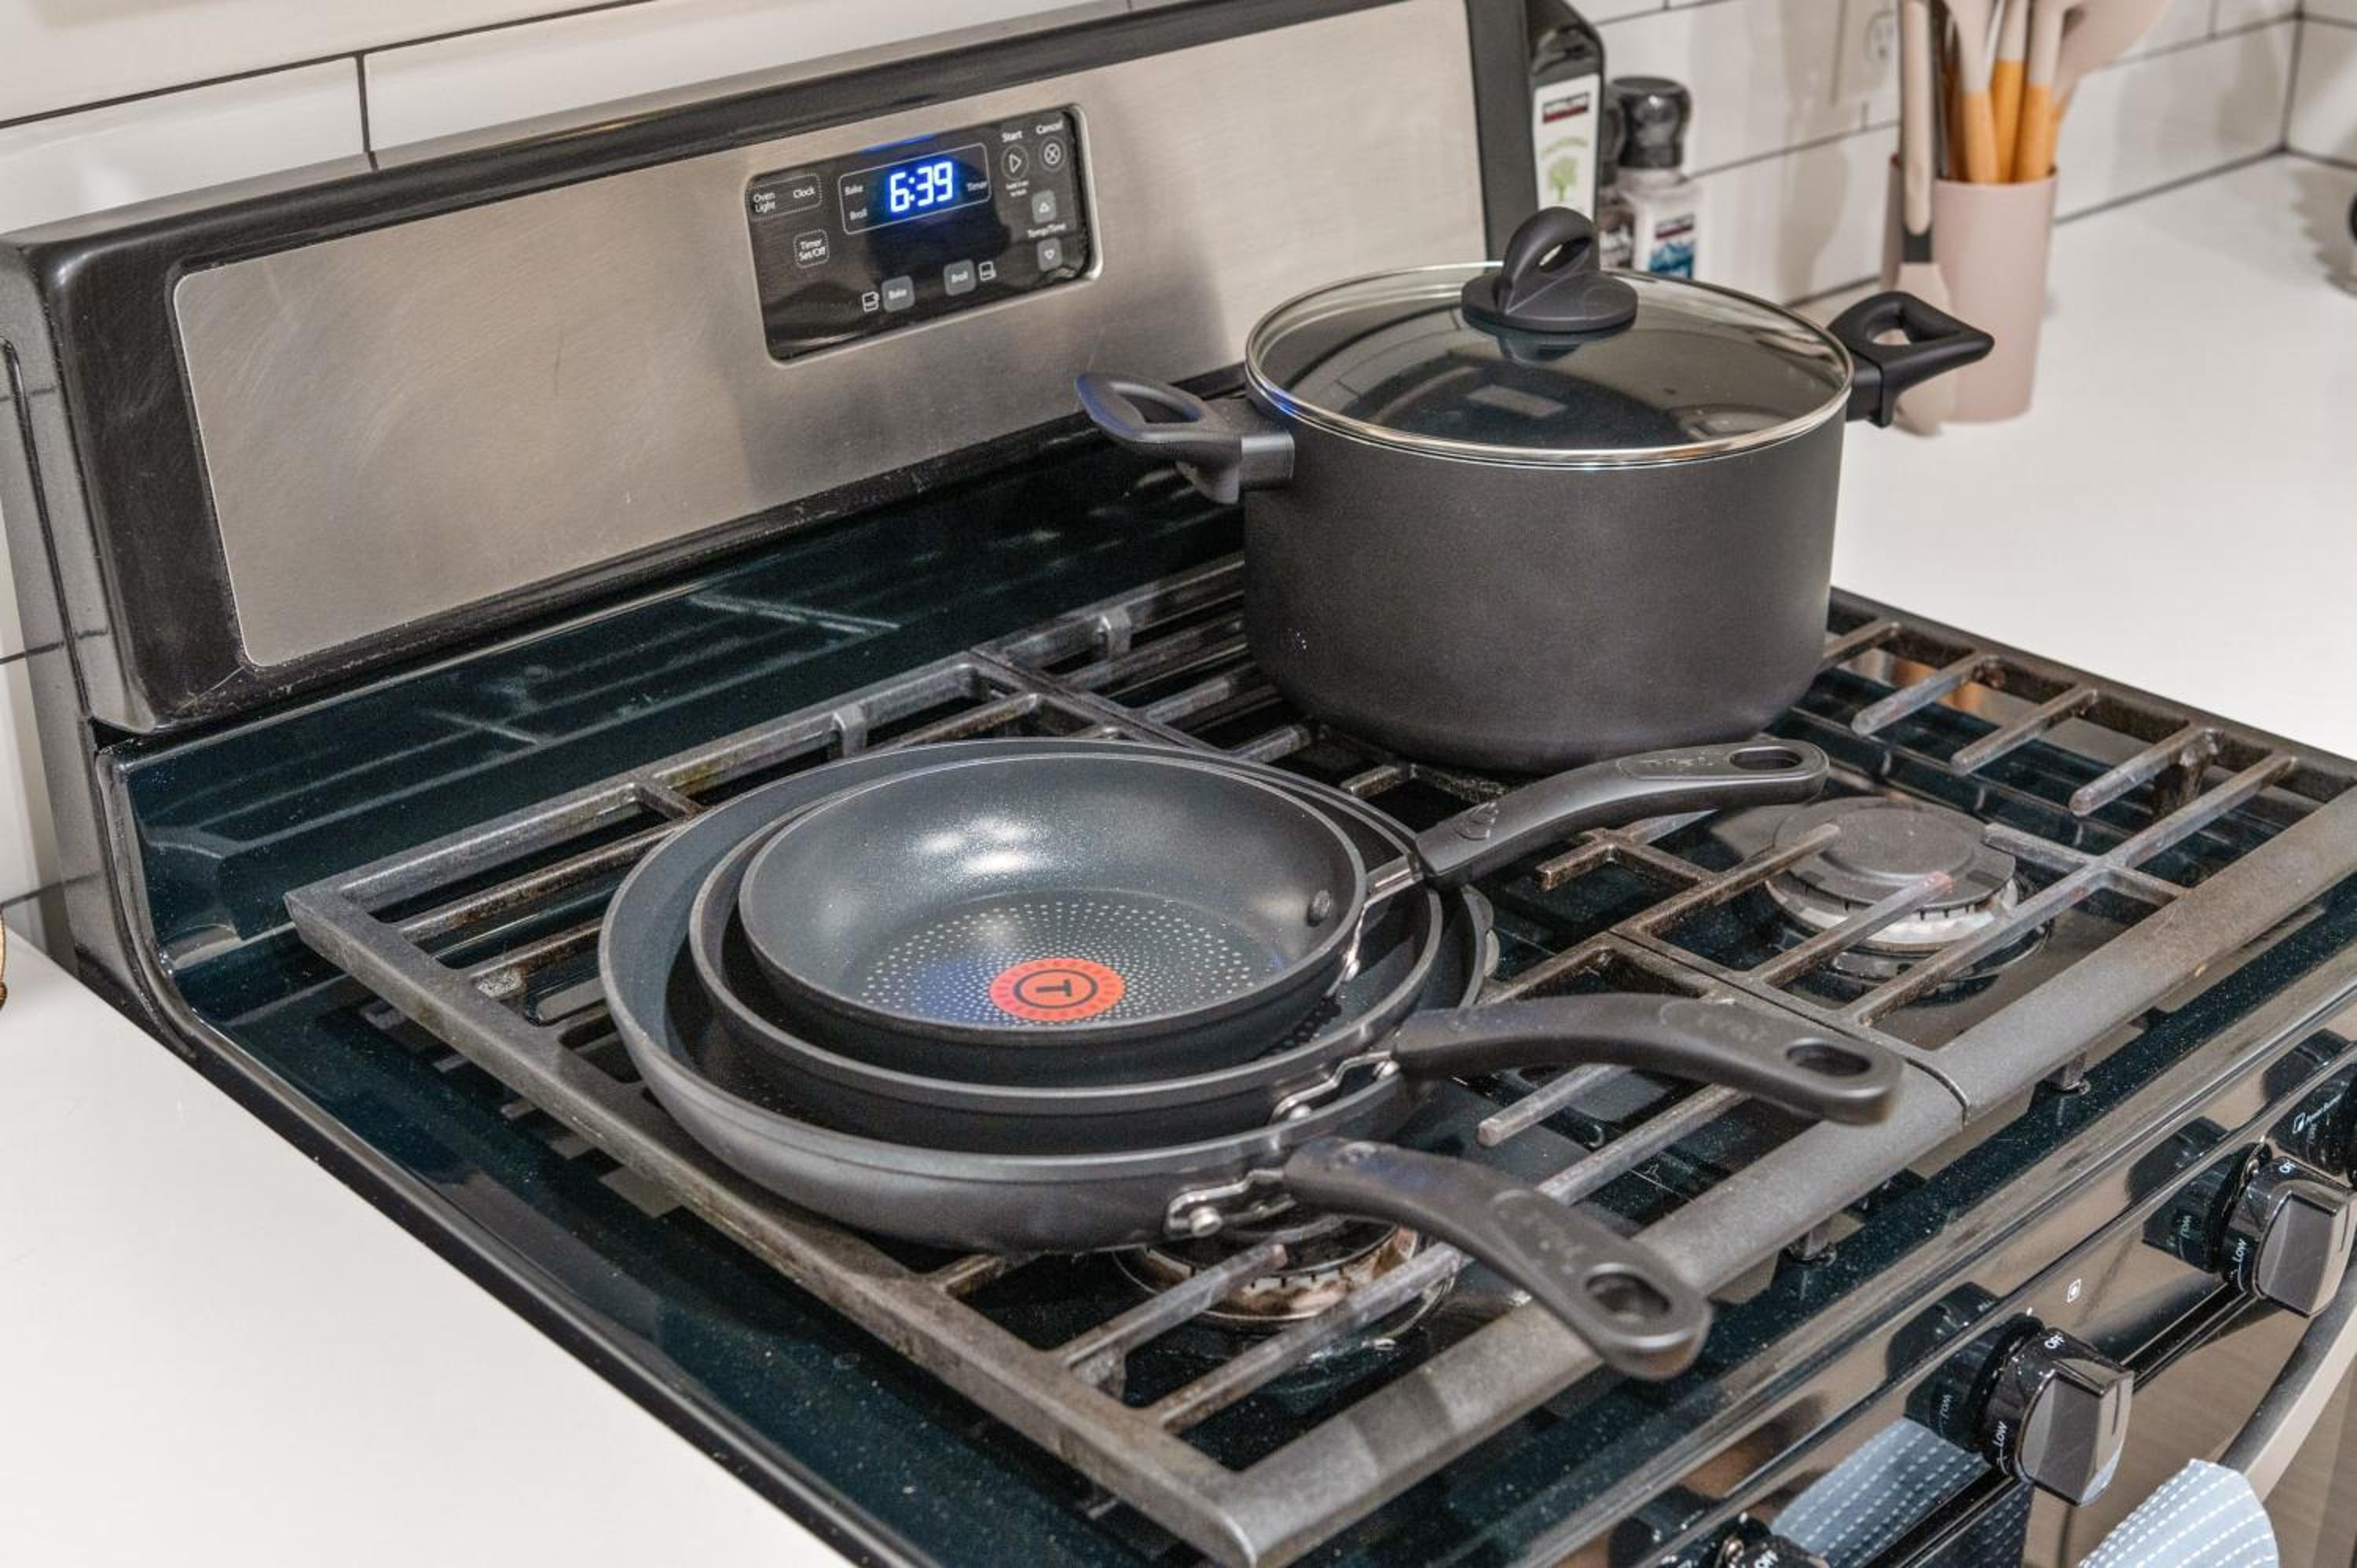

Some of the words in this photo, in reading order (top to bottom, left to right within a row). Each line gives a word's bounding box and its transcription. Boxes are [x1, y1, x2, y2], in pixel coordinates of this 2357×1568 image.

[1036, 120, 1063, 134] Cancel
[1003, 130, 1022, 142] Start
[793, 186, 816, 199] Clock
[845, 185, 863, 196] Bake
[890, 162, 953, 212] 6:39
[753, 192, 775, 203] Oven
[755, 201, 775, 213] Light
[1035, 979, 1072, 996] T
[2231, 1238, 2248, 1263] LOW
[1992, 1420, 2008, 1448] LOW
